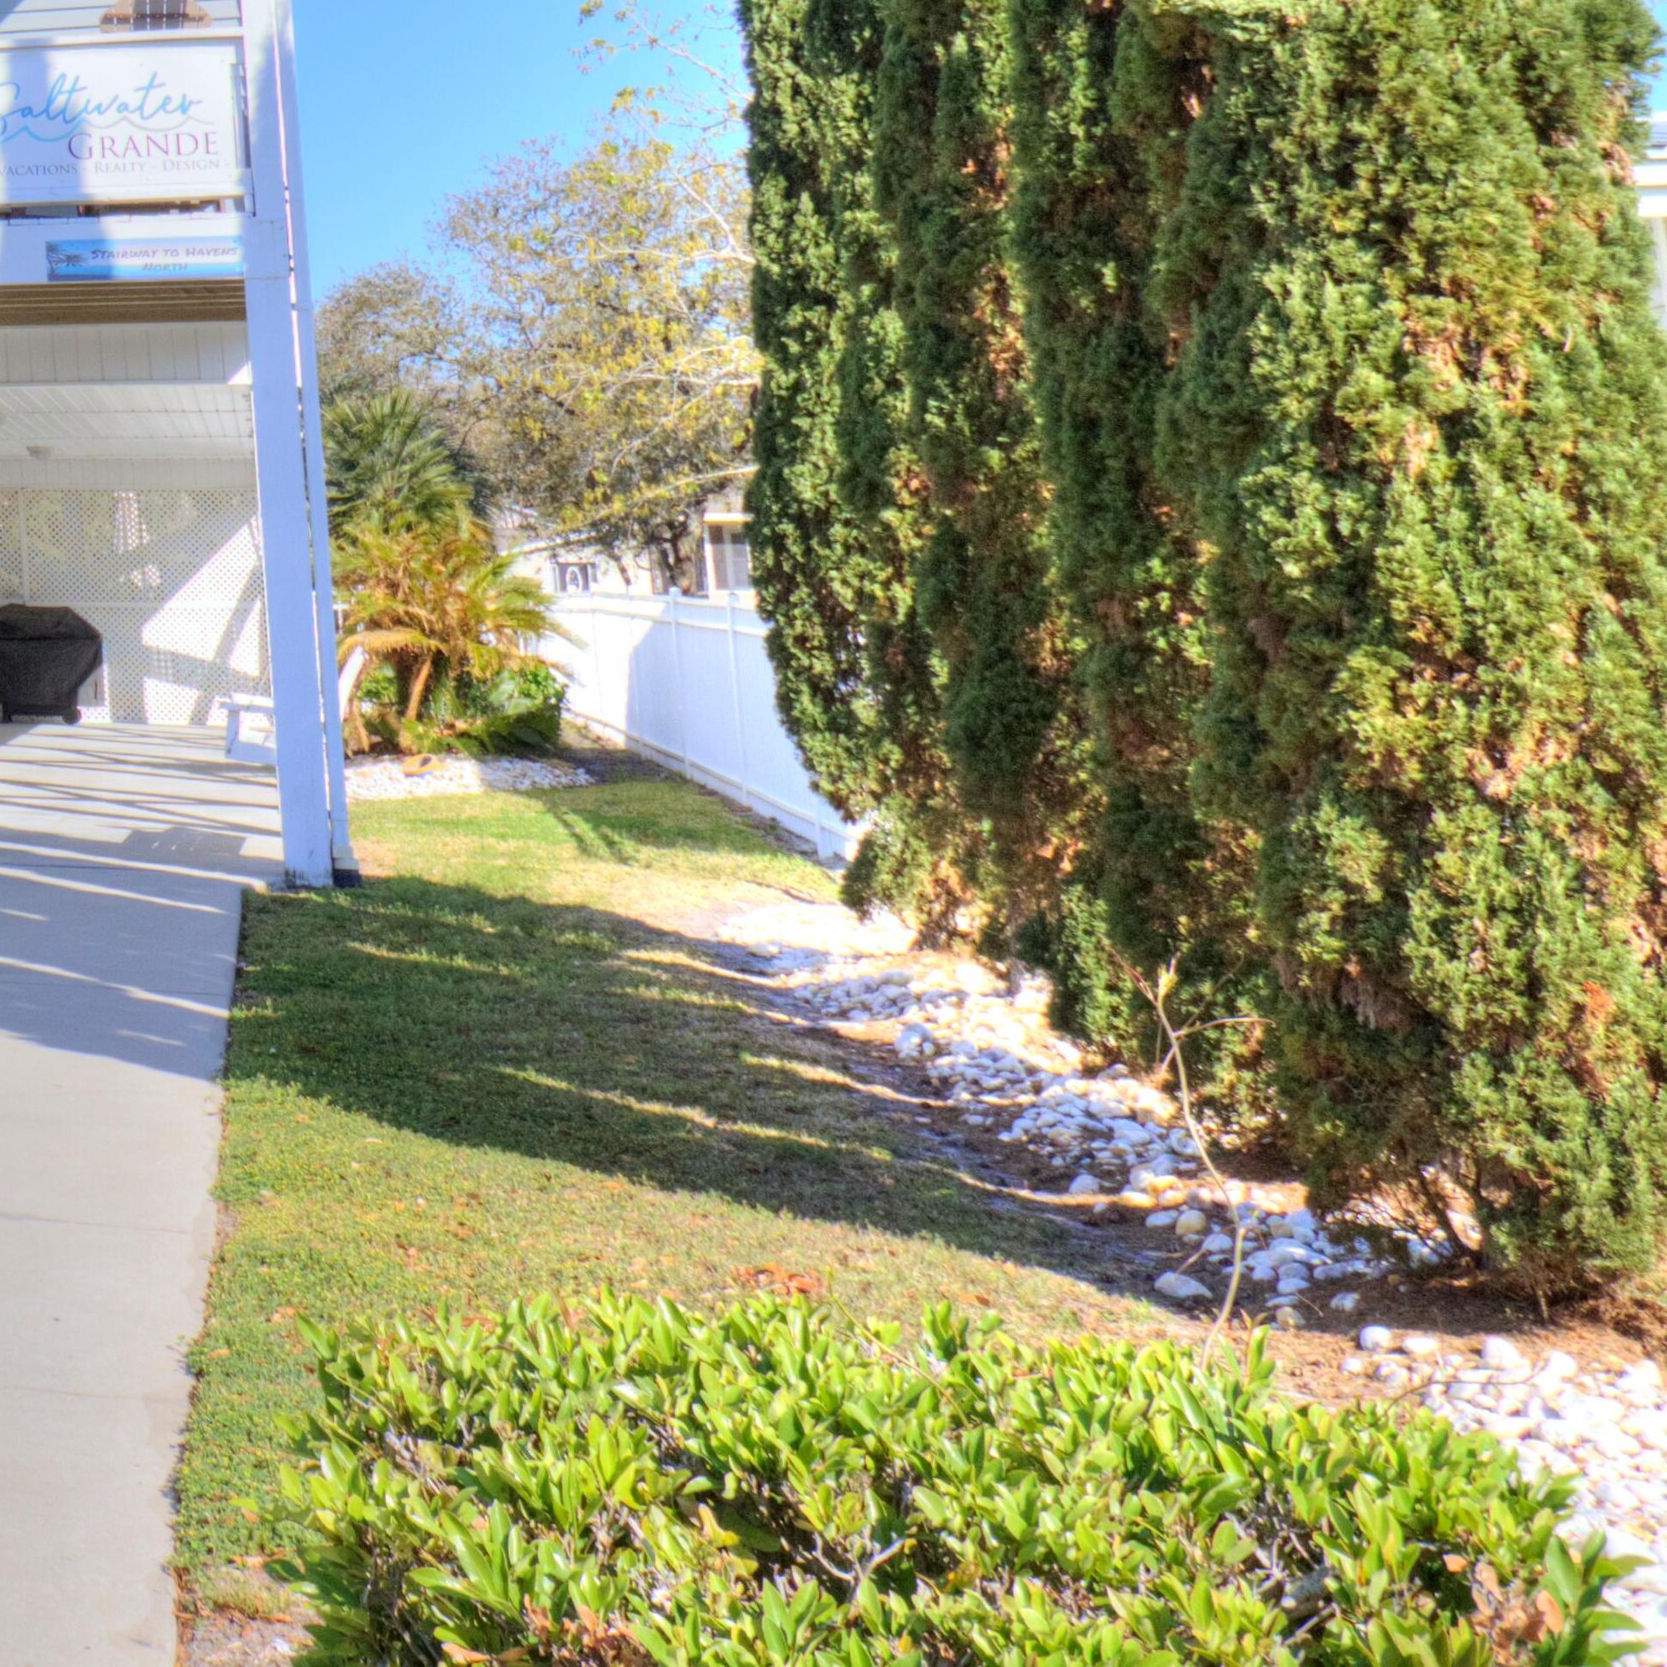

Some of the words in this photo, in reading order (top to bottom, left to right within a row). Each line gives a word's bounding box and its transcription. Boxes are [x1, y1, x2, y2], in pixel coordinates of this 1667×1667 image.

[67, 131, 219, 161] GRANDE
[94, 160, 148, 174] REALTY
[162, 158, 220, 172] DESIGN
[91, 248, 158, 260] STAIRWAY
[162, 248, 180, 258] TO
[186, 246, 239, 258] HAVENS
[143, 262, 188, 273] NORTH
